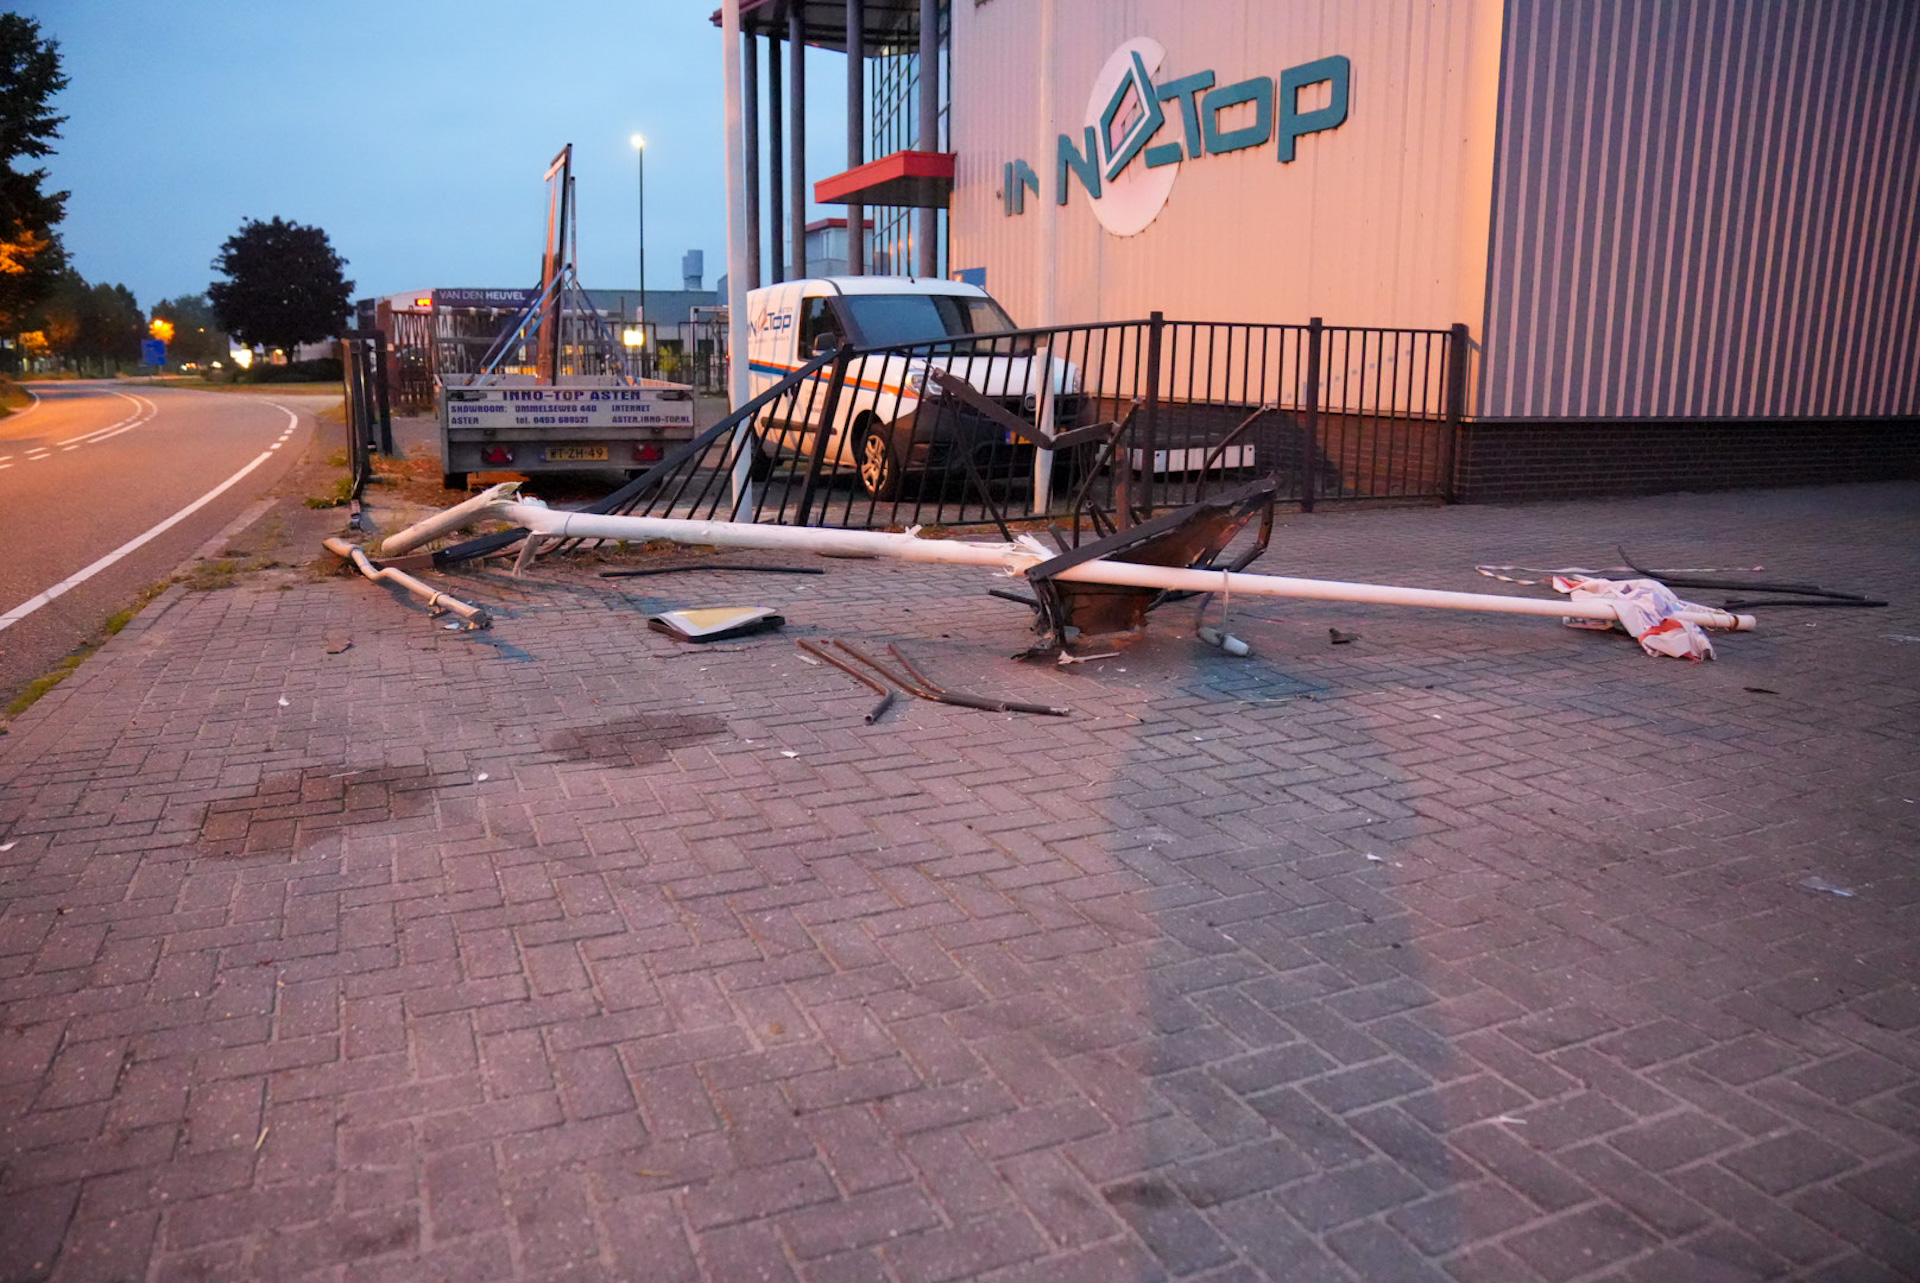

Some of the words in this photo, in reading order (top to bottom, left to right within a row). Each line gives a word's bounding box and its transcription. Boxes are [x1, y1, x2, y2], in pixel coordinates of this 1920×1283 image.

[439, 291, 460, 300] VAN
[462, 291, 484, 300] DEN
[485, 291, 526, 301] HEUVEL
[502, 390, 585, 401] INNO-TOP
[590, 390, 641, 401] ASTEN
[515, 404, 577, 413] OMMELSEWEG
[612, 404, 650, 412] INTERNET
[451, 416, 479, 425] ASTEN
[533, 416, 556, 424] 0493
